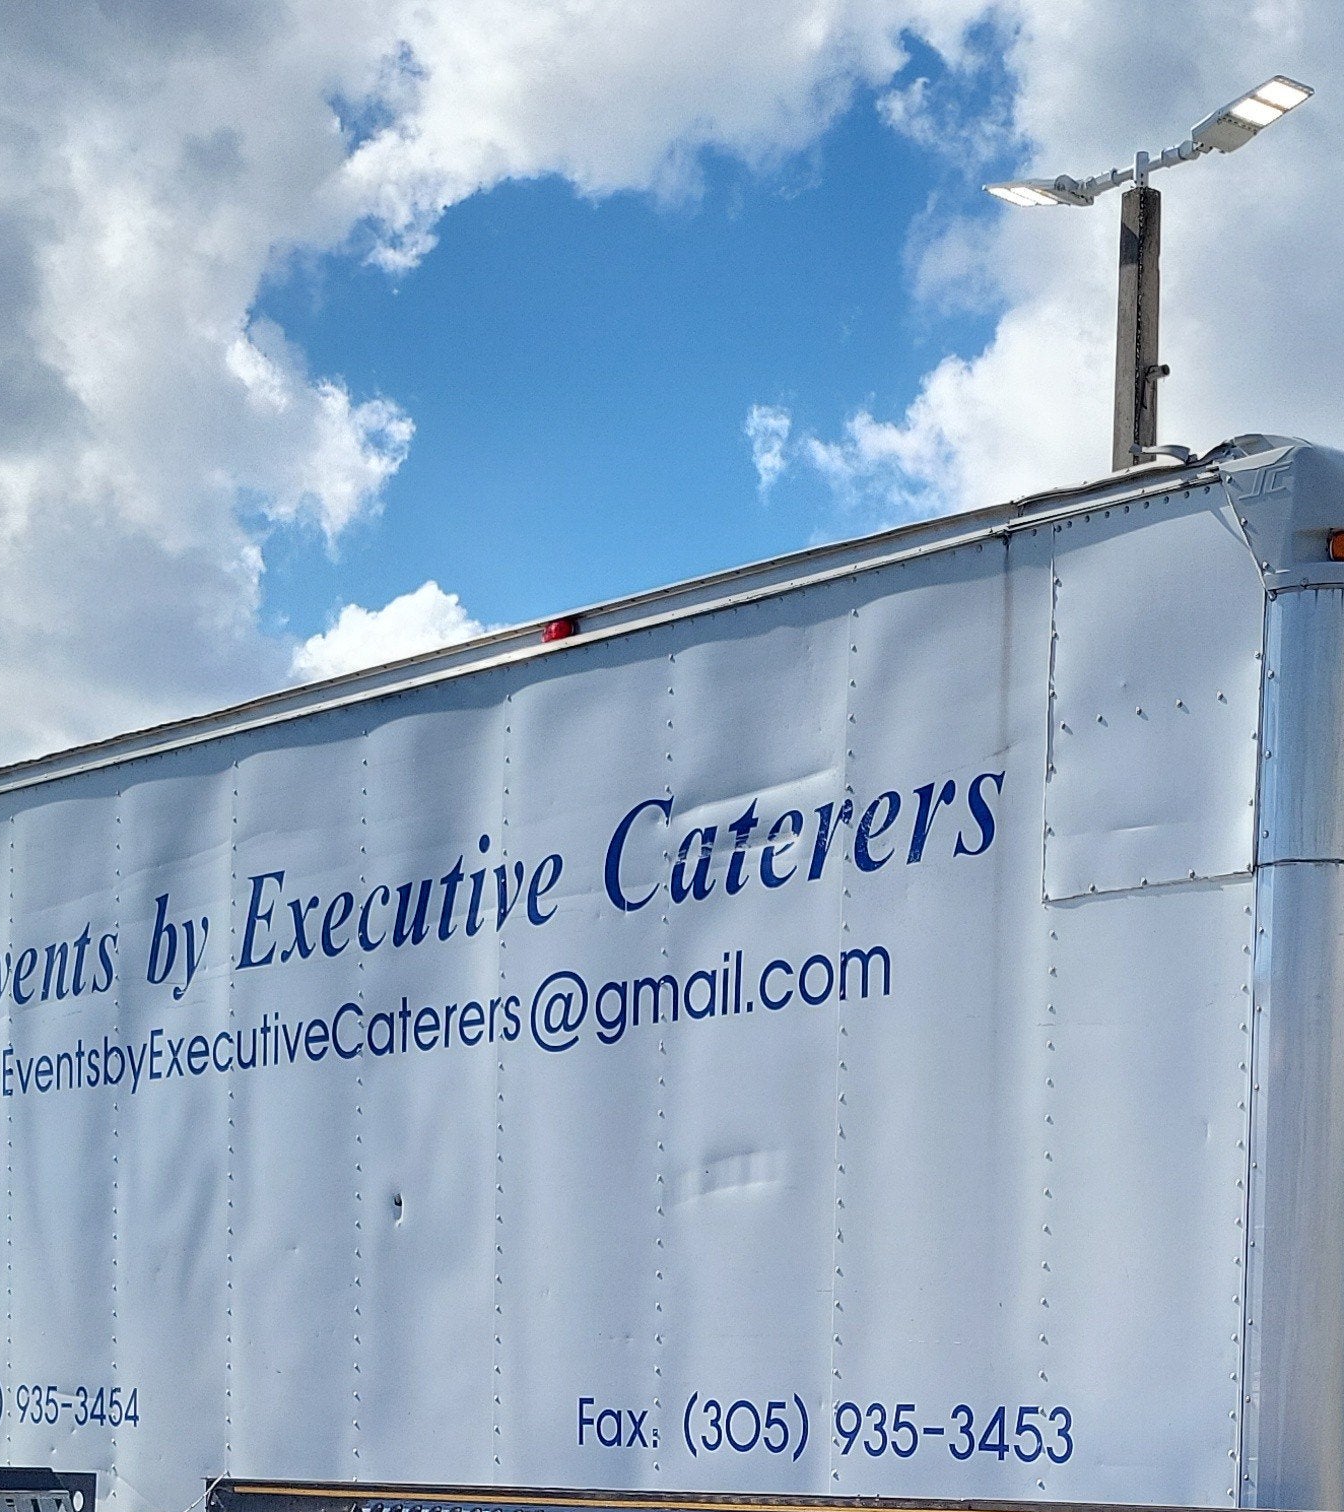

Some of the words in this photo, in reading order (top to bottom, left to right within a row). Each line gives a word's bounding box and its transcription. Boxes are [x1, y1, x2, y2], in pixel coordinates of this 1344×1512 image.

[146, 893, 210, 1000] by
[237, 833, 564, 971] Executive
[603, 770, 1006, 912] Caterers
[0, 944, 892, 1097] EventsbyExecutiveCaterers@gmail.com
[16, 1384, 140, 1428] 935-3454
[683, 1390, 810, 1462] (305)
[835, 1401, 1074, 1464] 935-3453
